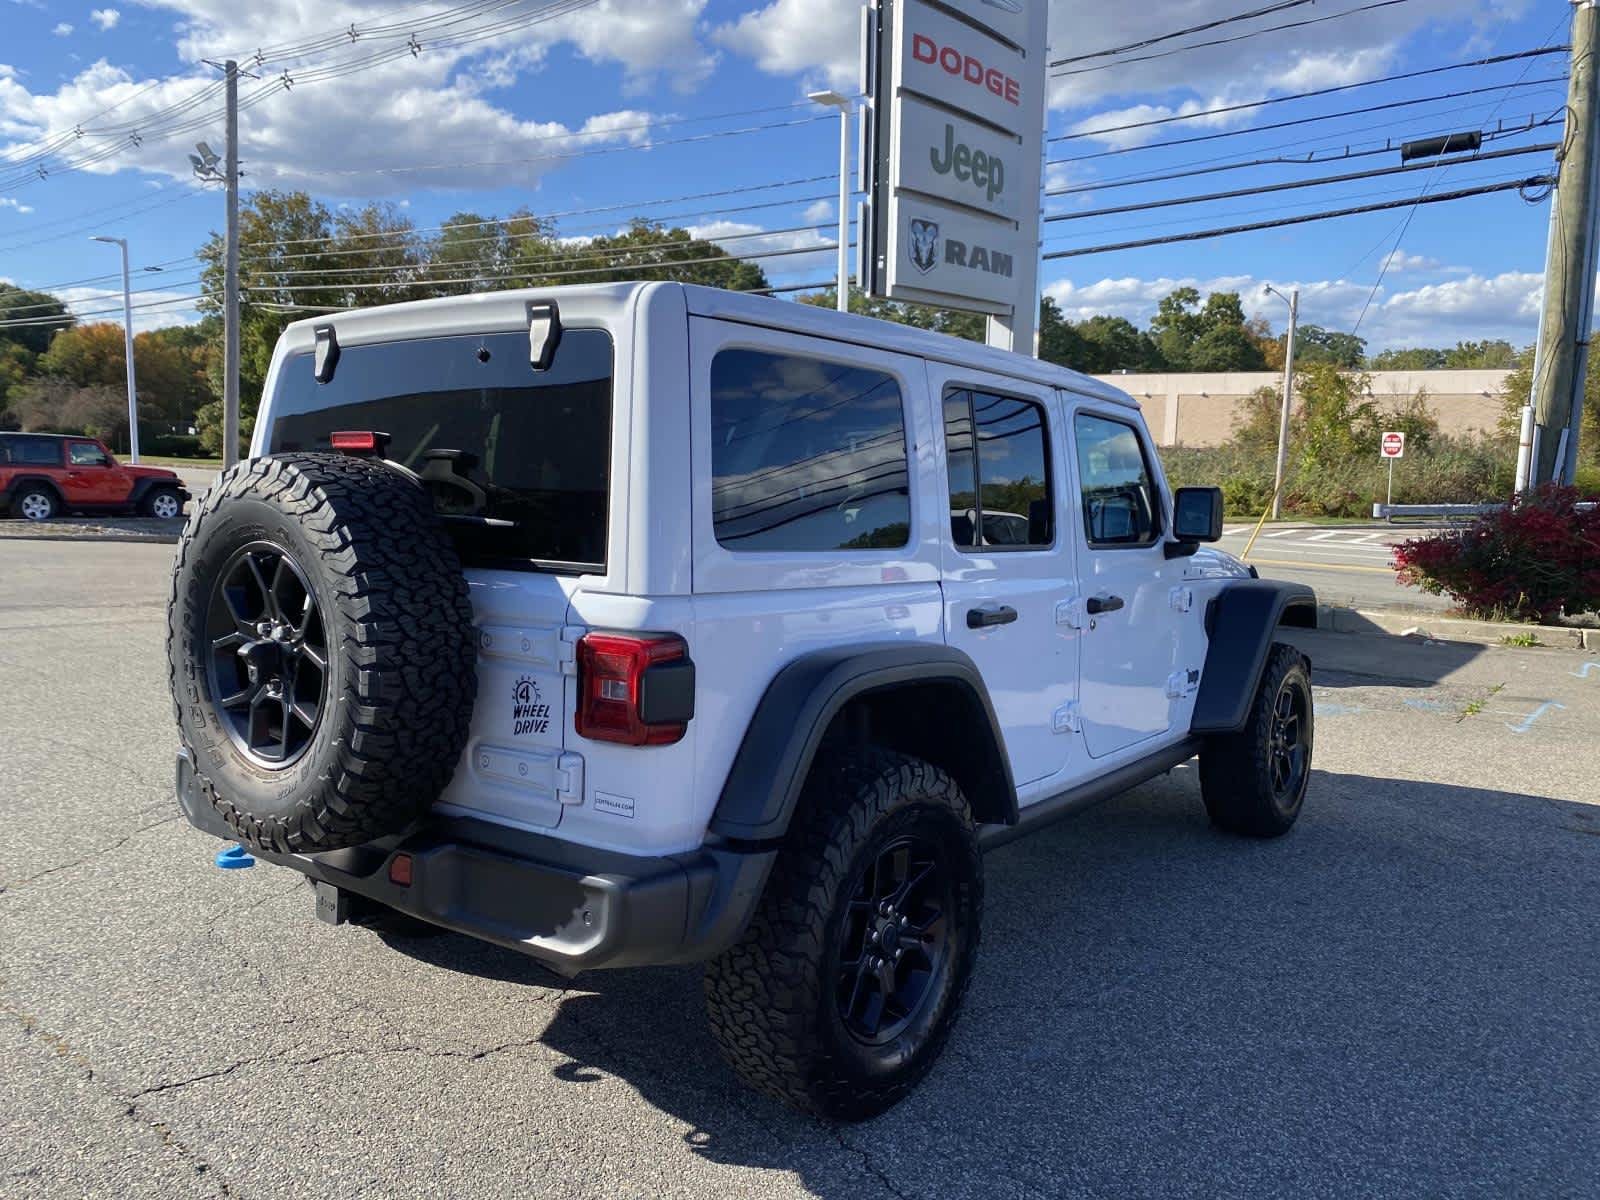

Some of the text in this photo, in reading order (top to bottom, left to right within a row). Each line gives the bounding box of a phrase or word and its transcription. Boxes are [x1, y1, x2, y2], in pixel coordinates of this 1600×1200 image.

[912, 33, 1020, 106] DODGE
[930, 124, 1004, 201] Jeep
[944, 239, 1014, 278] RAM
[519, 684, 530, 704] 4
[513, 704, 550, 719] WHEEL
[513, 719, 550, 736] DRIVE
